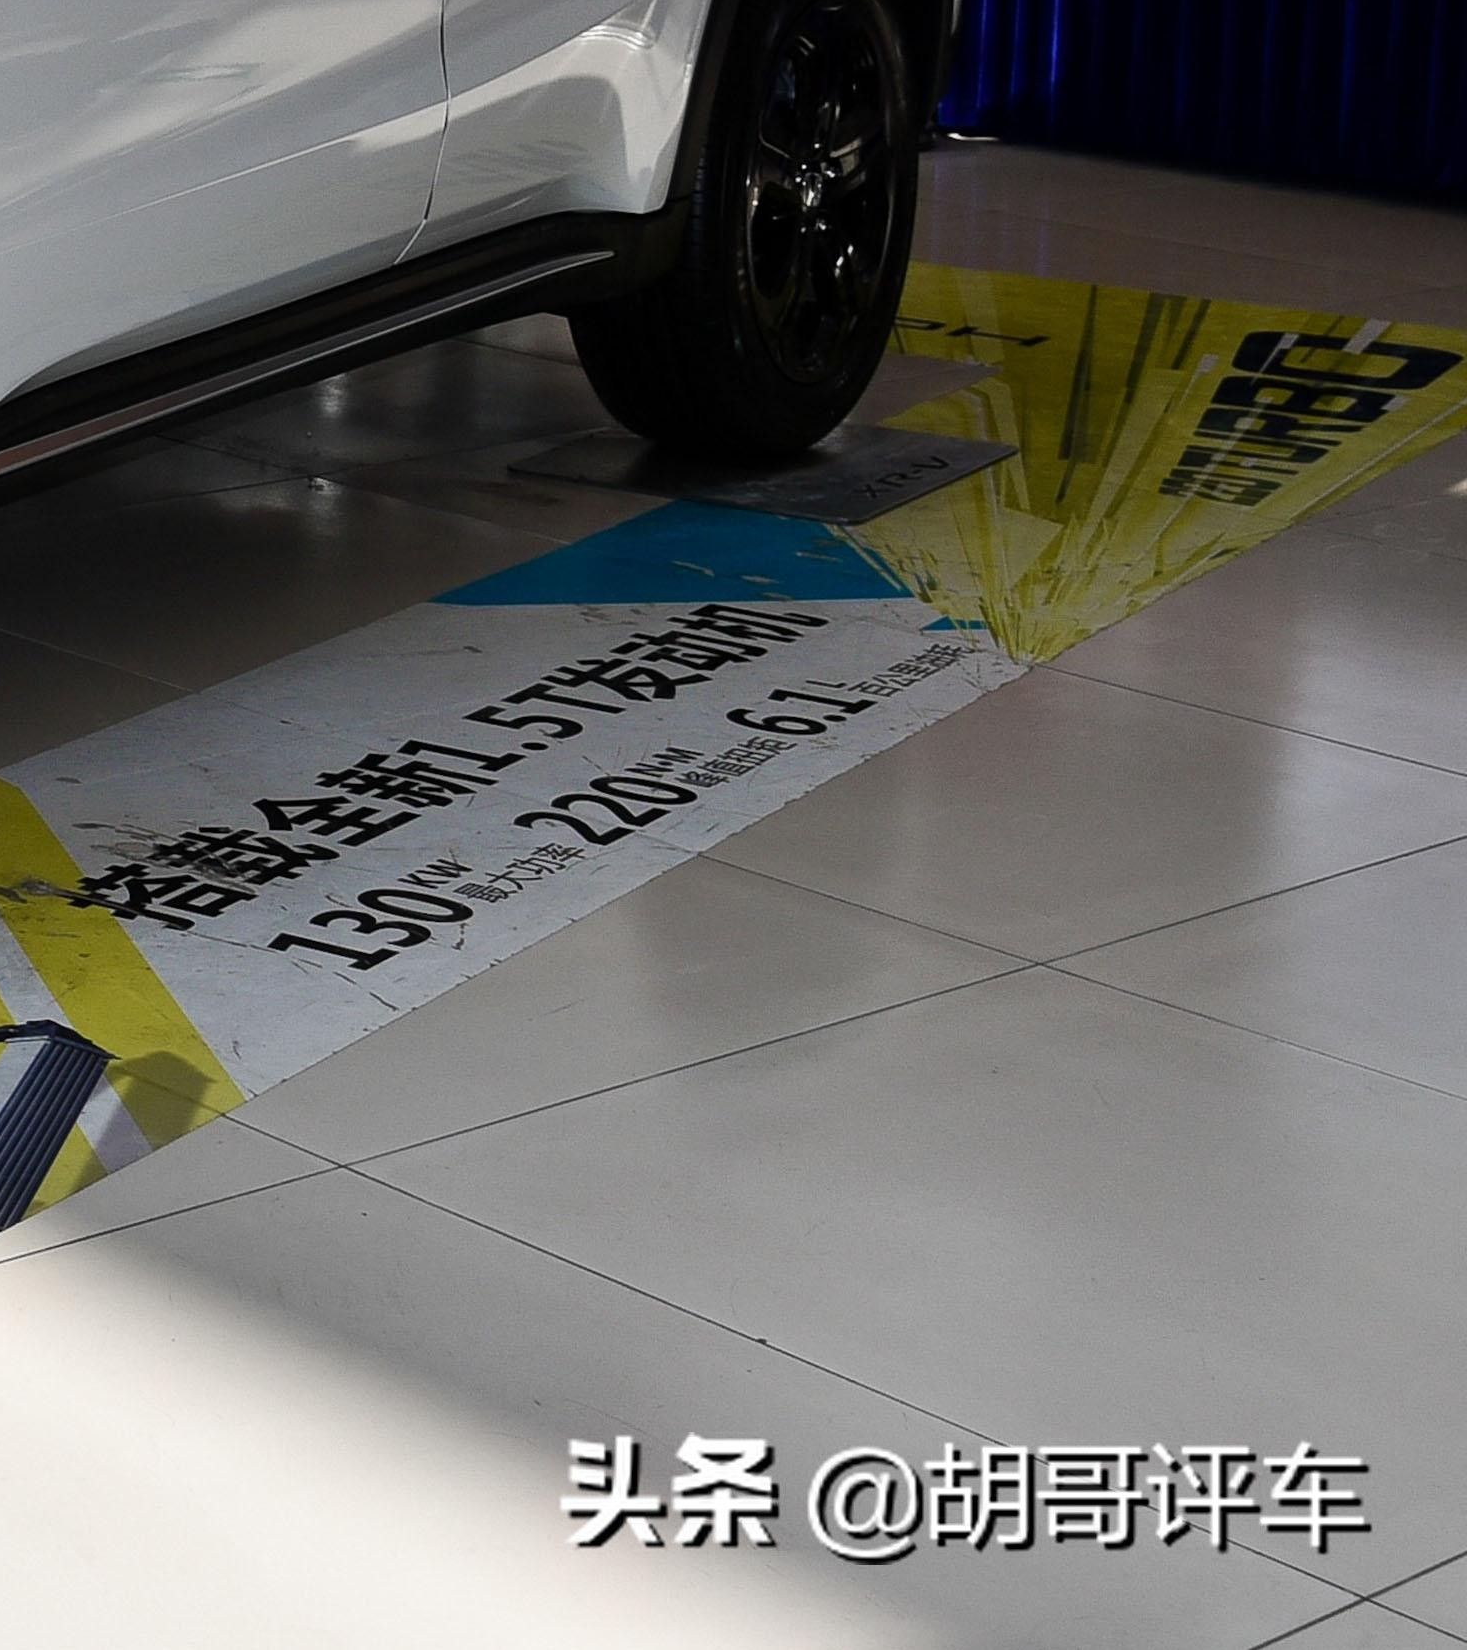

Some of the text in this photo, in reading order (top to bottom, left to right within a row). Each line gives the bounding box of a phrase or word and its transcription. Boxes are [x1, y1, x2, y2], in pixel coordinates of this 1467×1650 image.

[856, 453, 951, 501] XR-V
[513, 777, 700, 847] 220
[267, 887, 475, 971] 130
[455, 842, 592, 905] 最大功率
